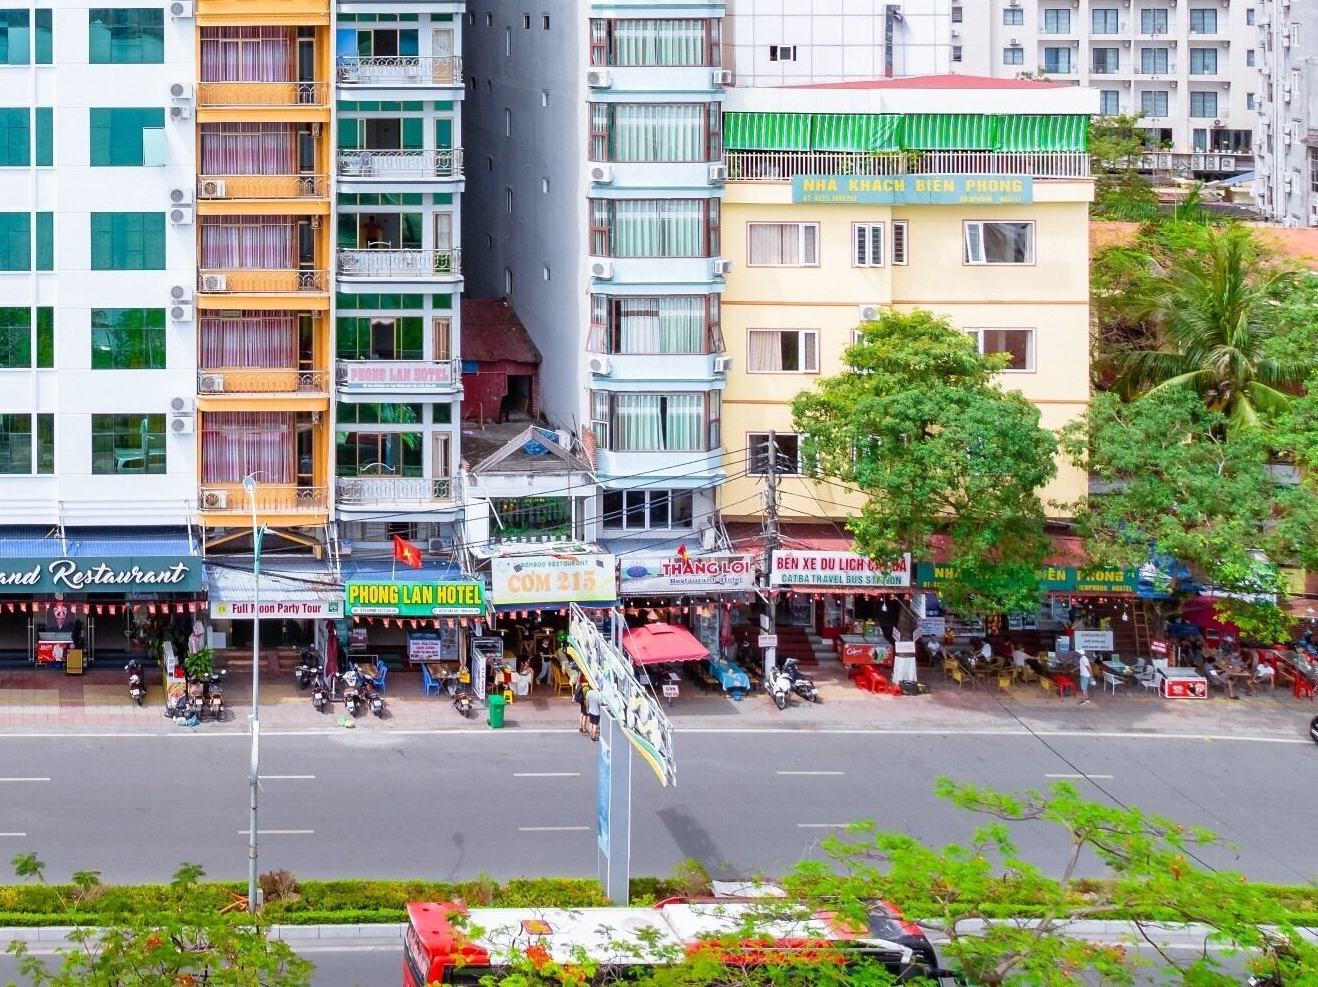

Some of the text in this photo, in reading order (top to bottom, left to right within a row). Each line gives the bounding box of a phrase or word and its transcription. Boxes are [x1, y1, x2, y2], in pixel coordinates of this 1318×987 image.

[351, 368, 449, 381] PHONG LAN HOTEL
[803, 557, 817, 570] XE
[821, 558, 835, 570] DU
[48, 559, 190, 590] Restaurant
[556, 570, 597, 591] 215
[782, 574, 809, 583] CATBA
[812, 574, 843, 583] TRAVEL
[846, 575, 863, 584] BUS
[349, 585, 482, 604] PHONG LAN HOTEL
[232, 604, 248, 613] Full
[277, 604, 300, 615] Party
[302, 604, 322, 613] Tour
